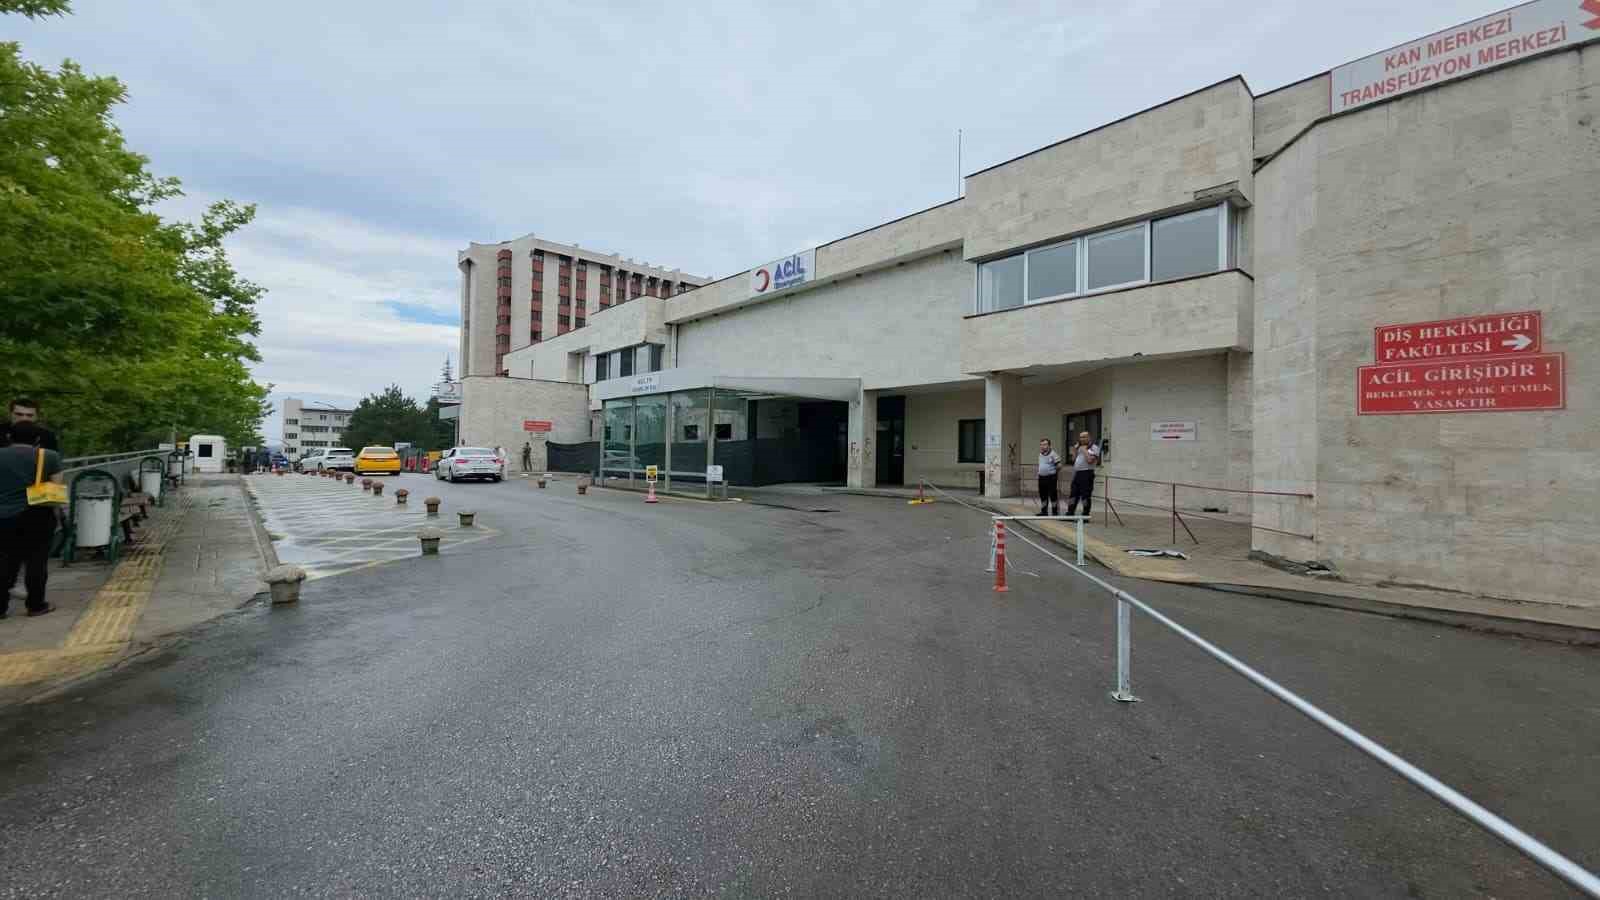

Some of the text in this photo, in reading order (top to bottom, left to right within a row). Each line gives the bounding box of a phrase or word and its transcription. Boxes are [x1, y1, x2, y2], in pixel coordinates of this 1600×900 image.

[1384, 13, 1512, 72] KAN MERKEZİ
[1341, 20, 1567, 106] TRANSFÜZYON MERKEZİ
[775, 255, 804, 280] ACİL
[1384, 316, 1530, 344] DİŞ HEKİMLİĞİ
[1385, 337, 1491, 360] FAKÜLTESİ
[1368, 368, 1416, 384] ACİL
[1424, 362, 1536, 382] GİRİŞİDİR
